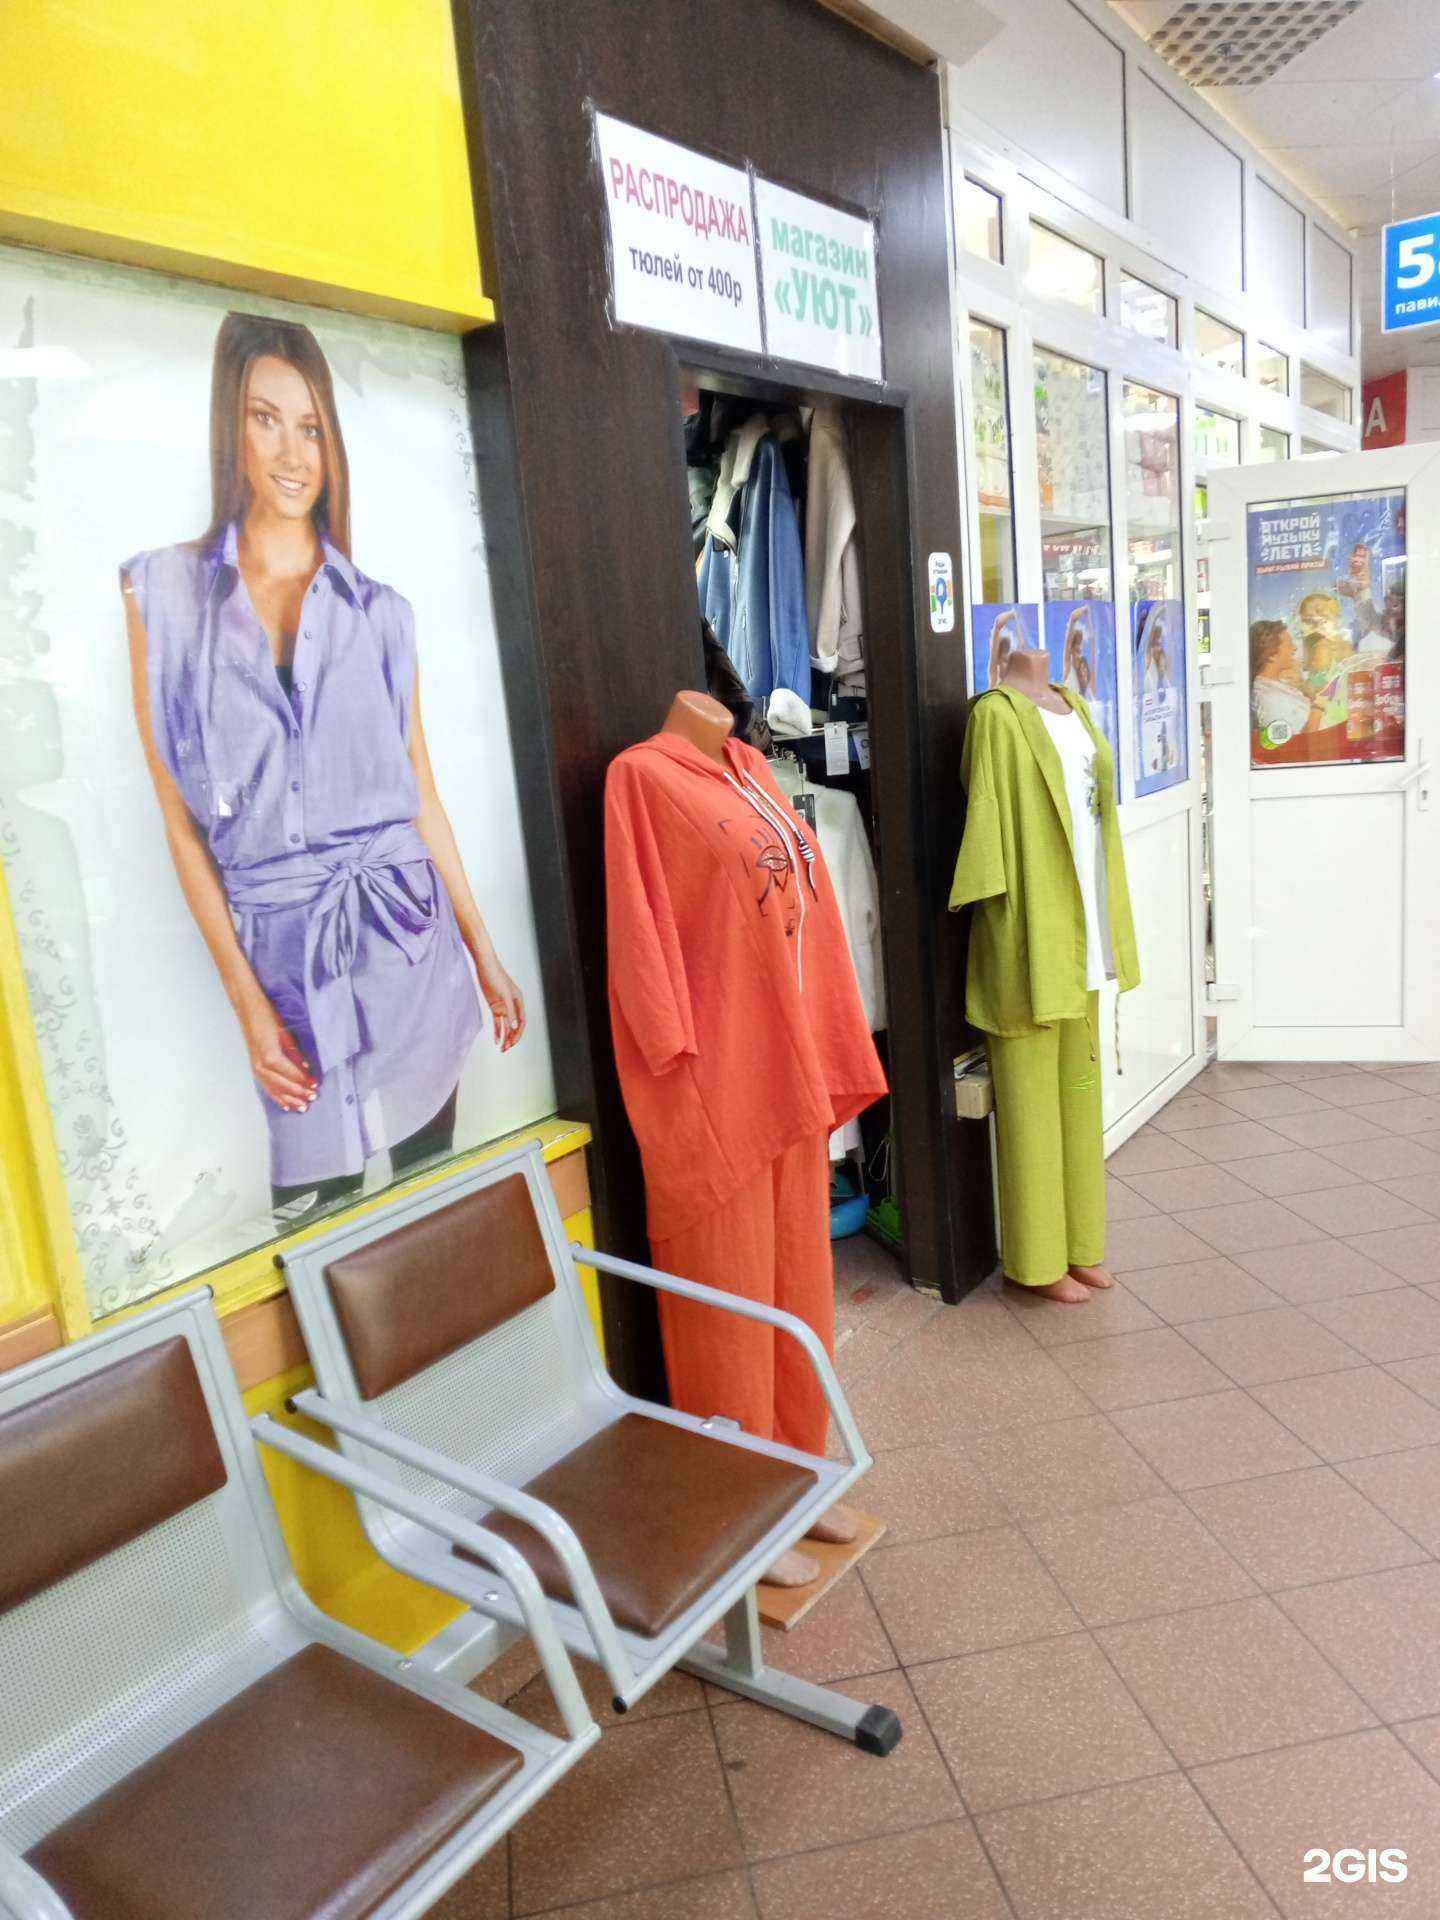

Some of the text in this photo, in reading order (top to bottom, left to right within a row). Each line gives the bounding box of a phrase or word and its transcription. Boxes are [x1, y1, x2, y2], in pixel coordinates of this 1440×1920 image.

[609, 157, 750, 246] РАСПРОДАЖА
[629, 246, 742, 307] тюлей от 400р
[771, 217, 868, 280] магазин
[1397, 233, 1440, 290] 5
[774, 267, 873, 337] «УЮТ»
[1395, 296, 1440, 315] пави
